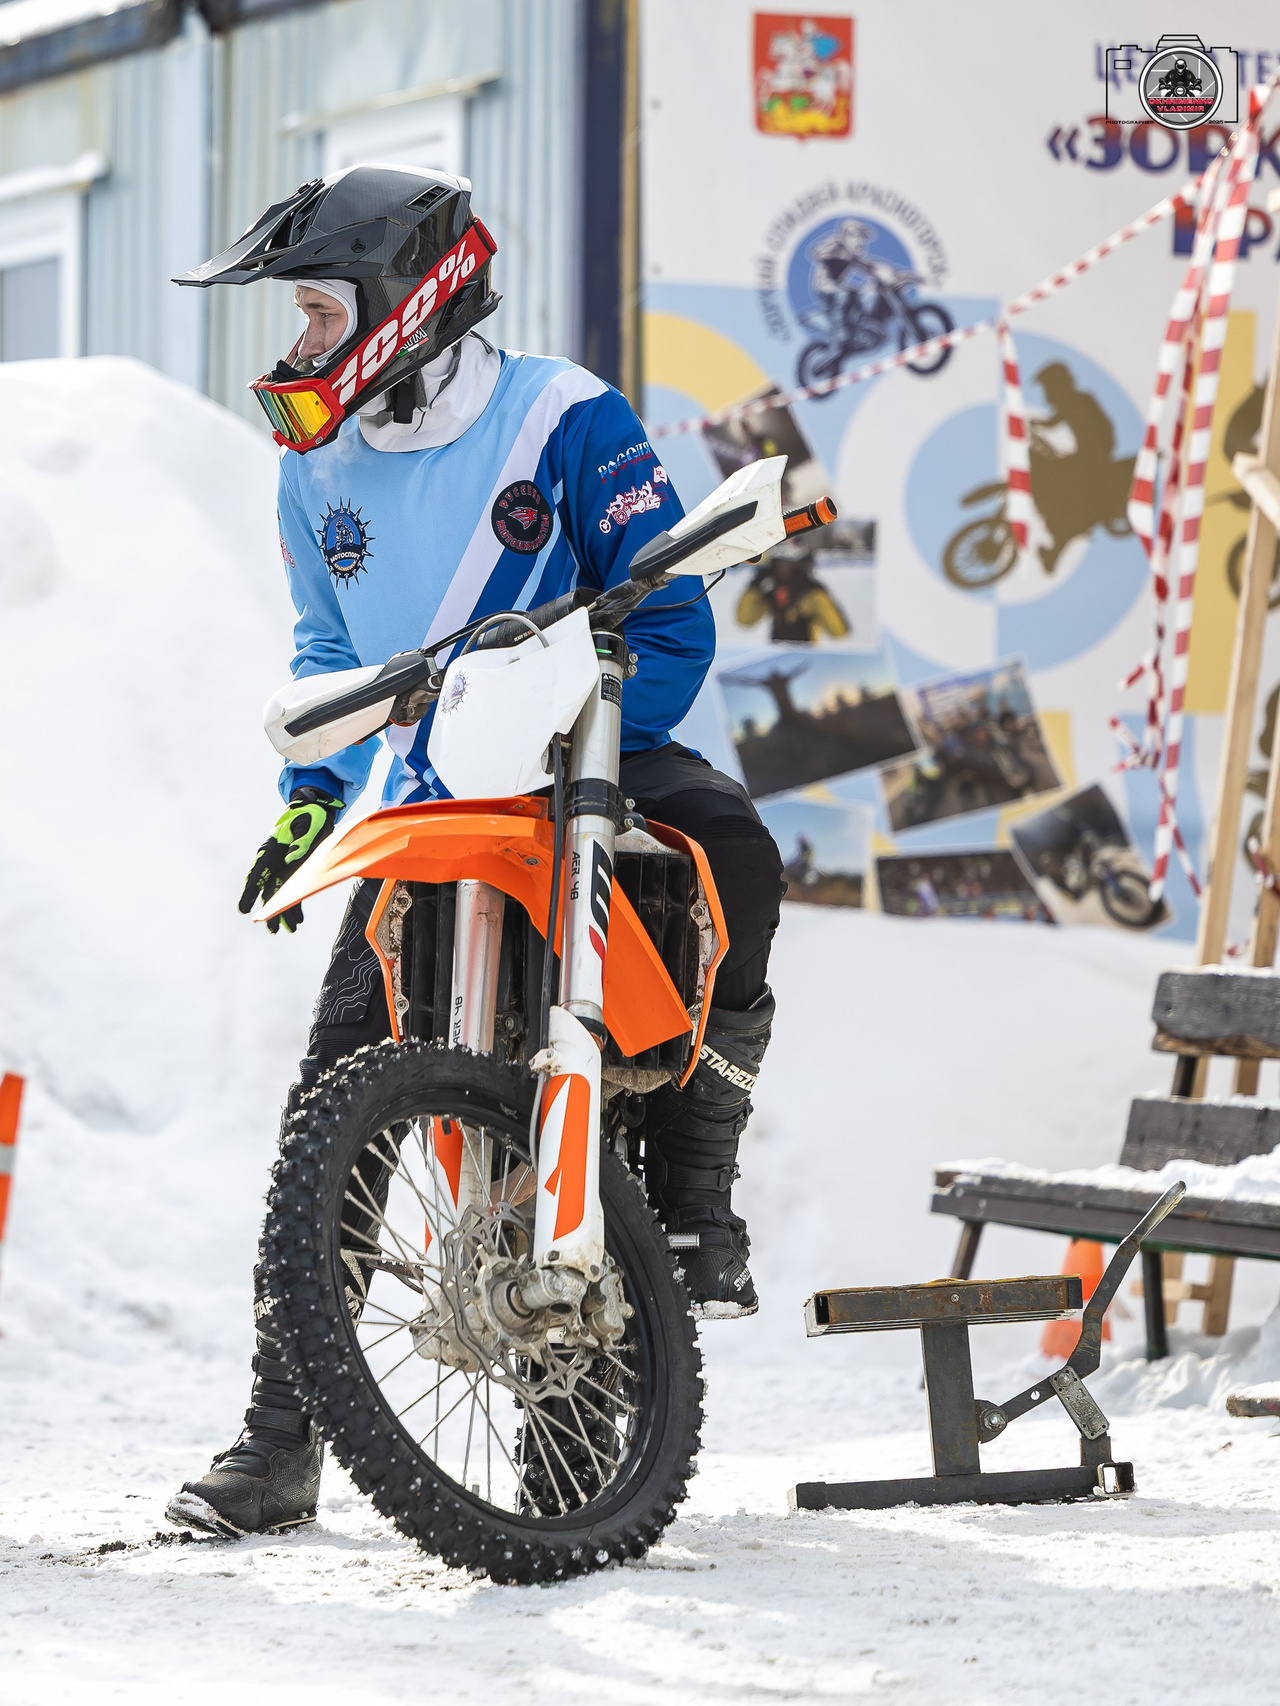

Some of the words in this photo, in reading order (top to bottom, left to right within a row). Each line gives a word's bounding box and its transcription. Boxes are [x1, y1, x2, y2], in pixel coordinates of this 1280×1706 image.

[331, 240, 476, 406] 100%
[330, 551, 361, 564] МОТОСПОРТ
[571, 850, 581, 878] AER
[570, 880, 580, 901] 48
[455, 995, 463, 1017] 48
